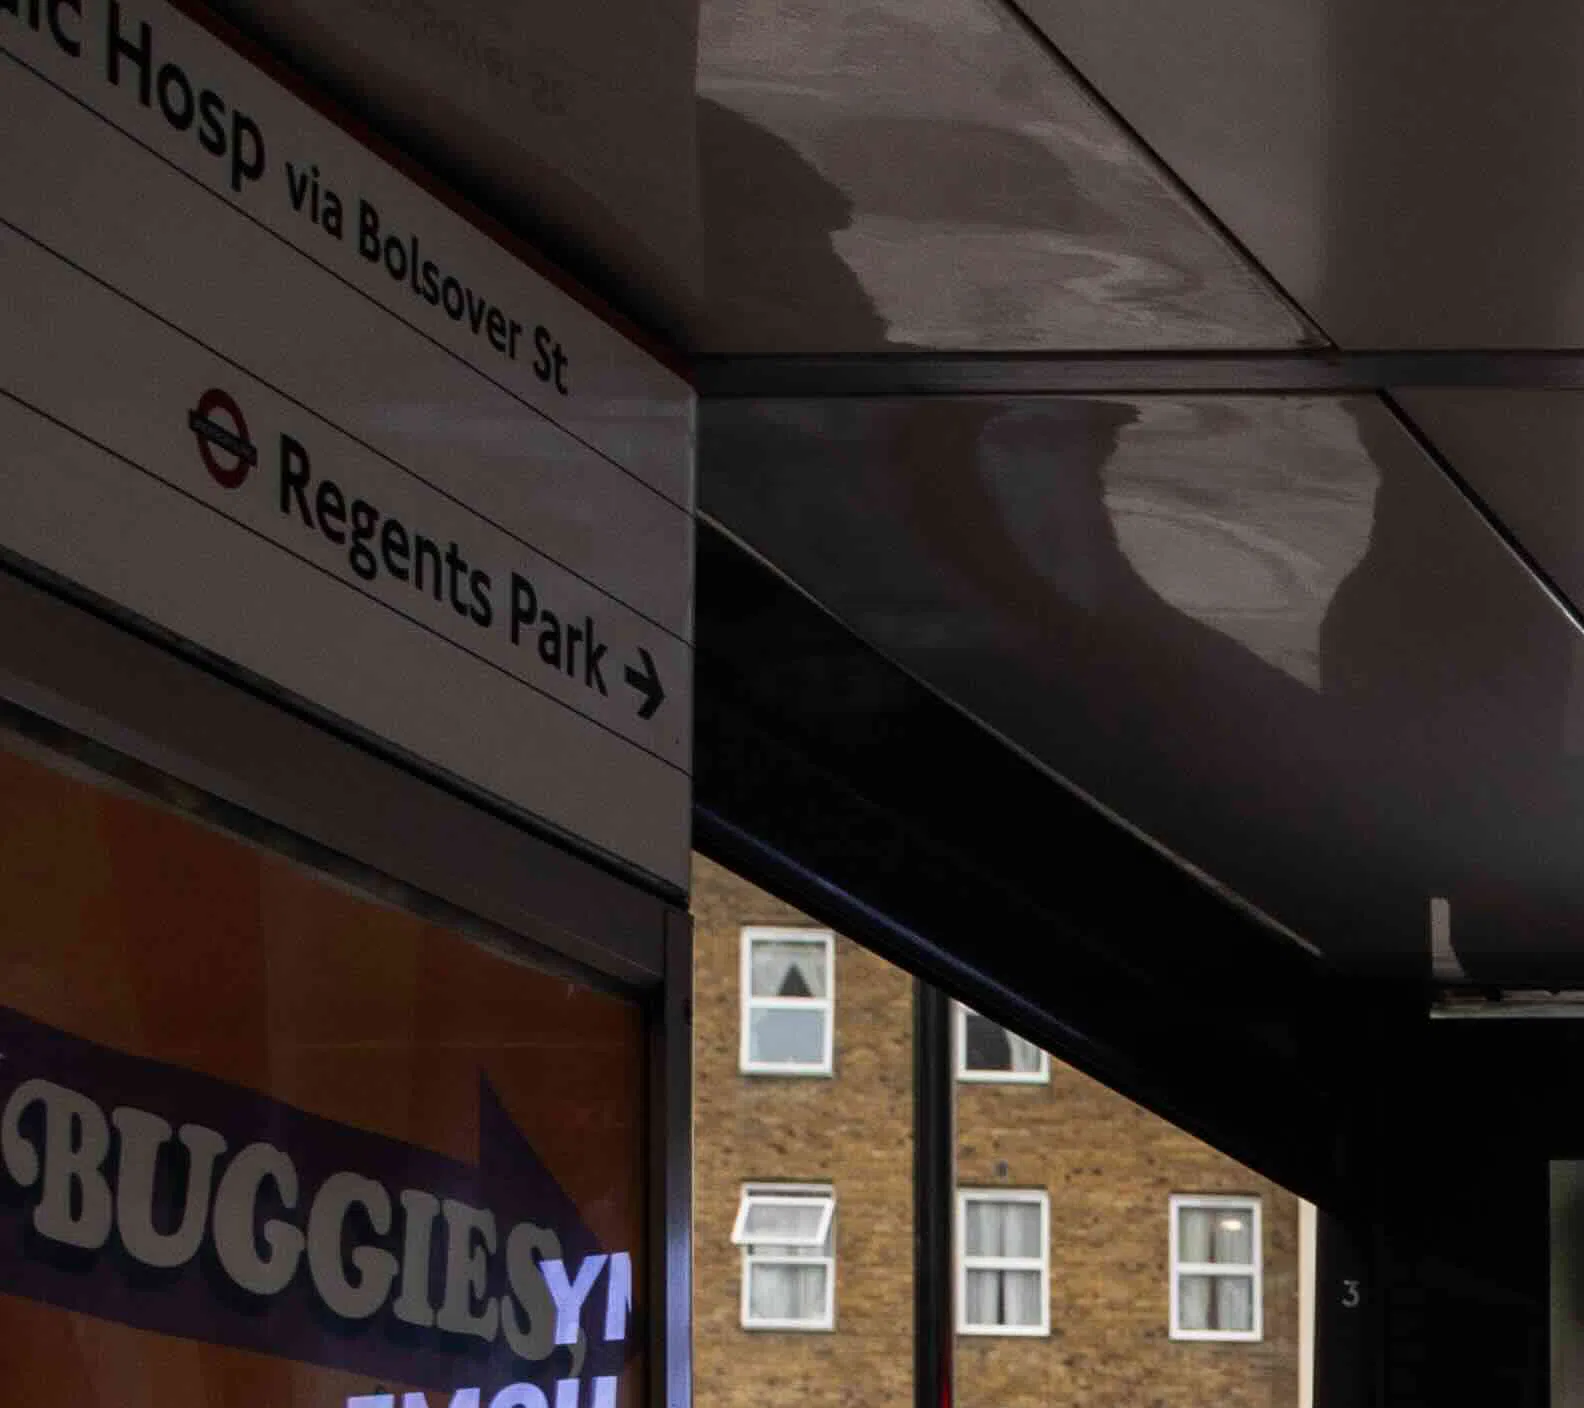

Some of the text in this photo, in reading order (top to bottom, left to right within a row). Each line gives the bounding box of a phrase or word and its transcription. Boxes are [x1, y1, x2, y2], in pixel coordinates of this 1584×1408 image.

[107, 0, 266, 193] Hosp
[285, 158, 344, 243] via
[358, 200, 523, 361] Bolsover
[534, 325, 570, 399] St
[278, 432, 609, 698] Regents Park
[1, 1078, 587, 1377] BUGGIES,
[1341, 1279, 1361, 1309] 3
